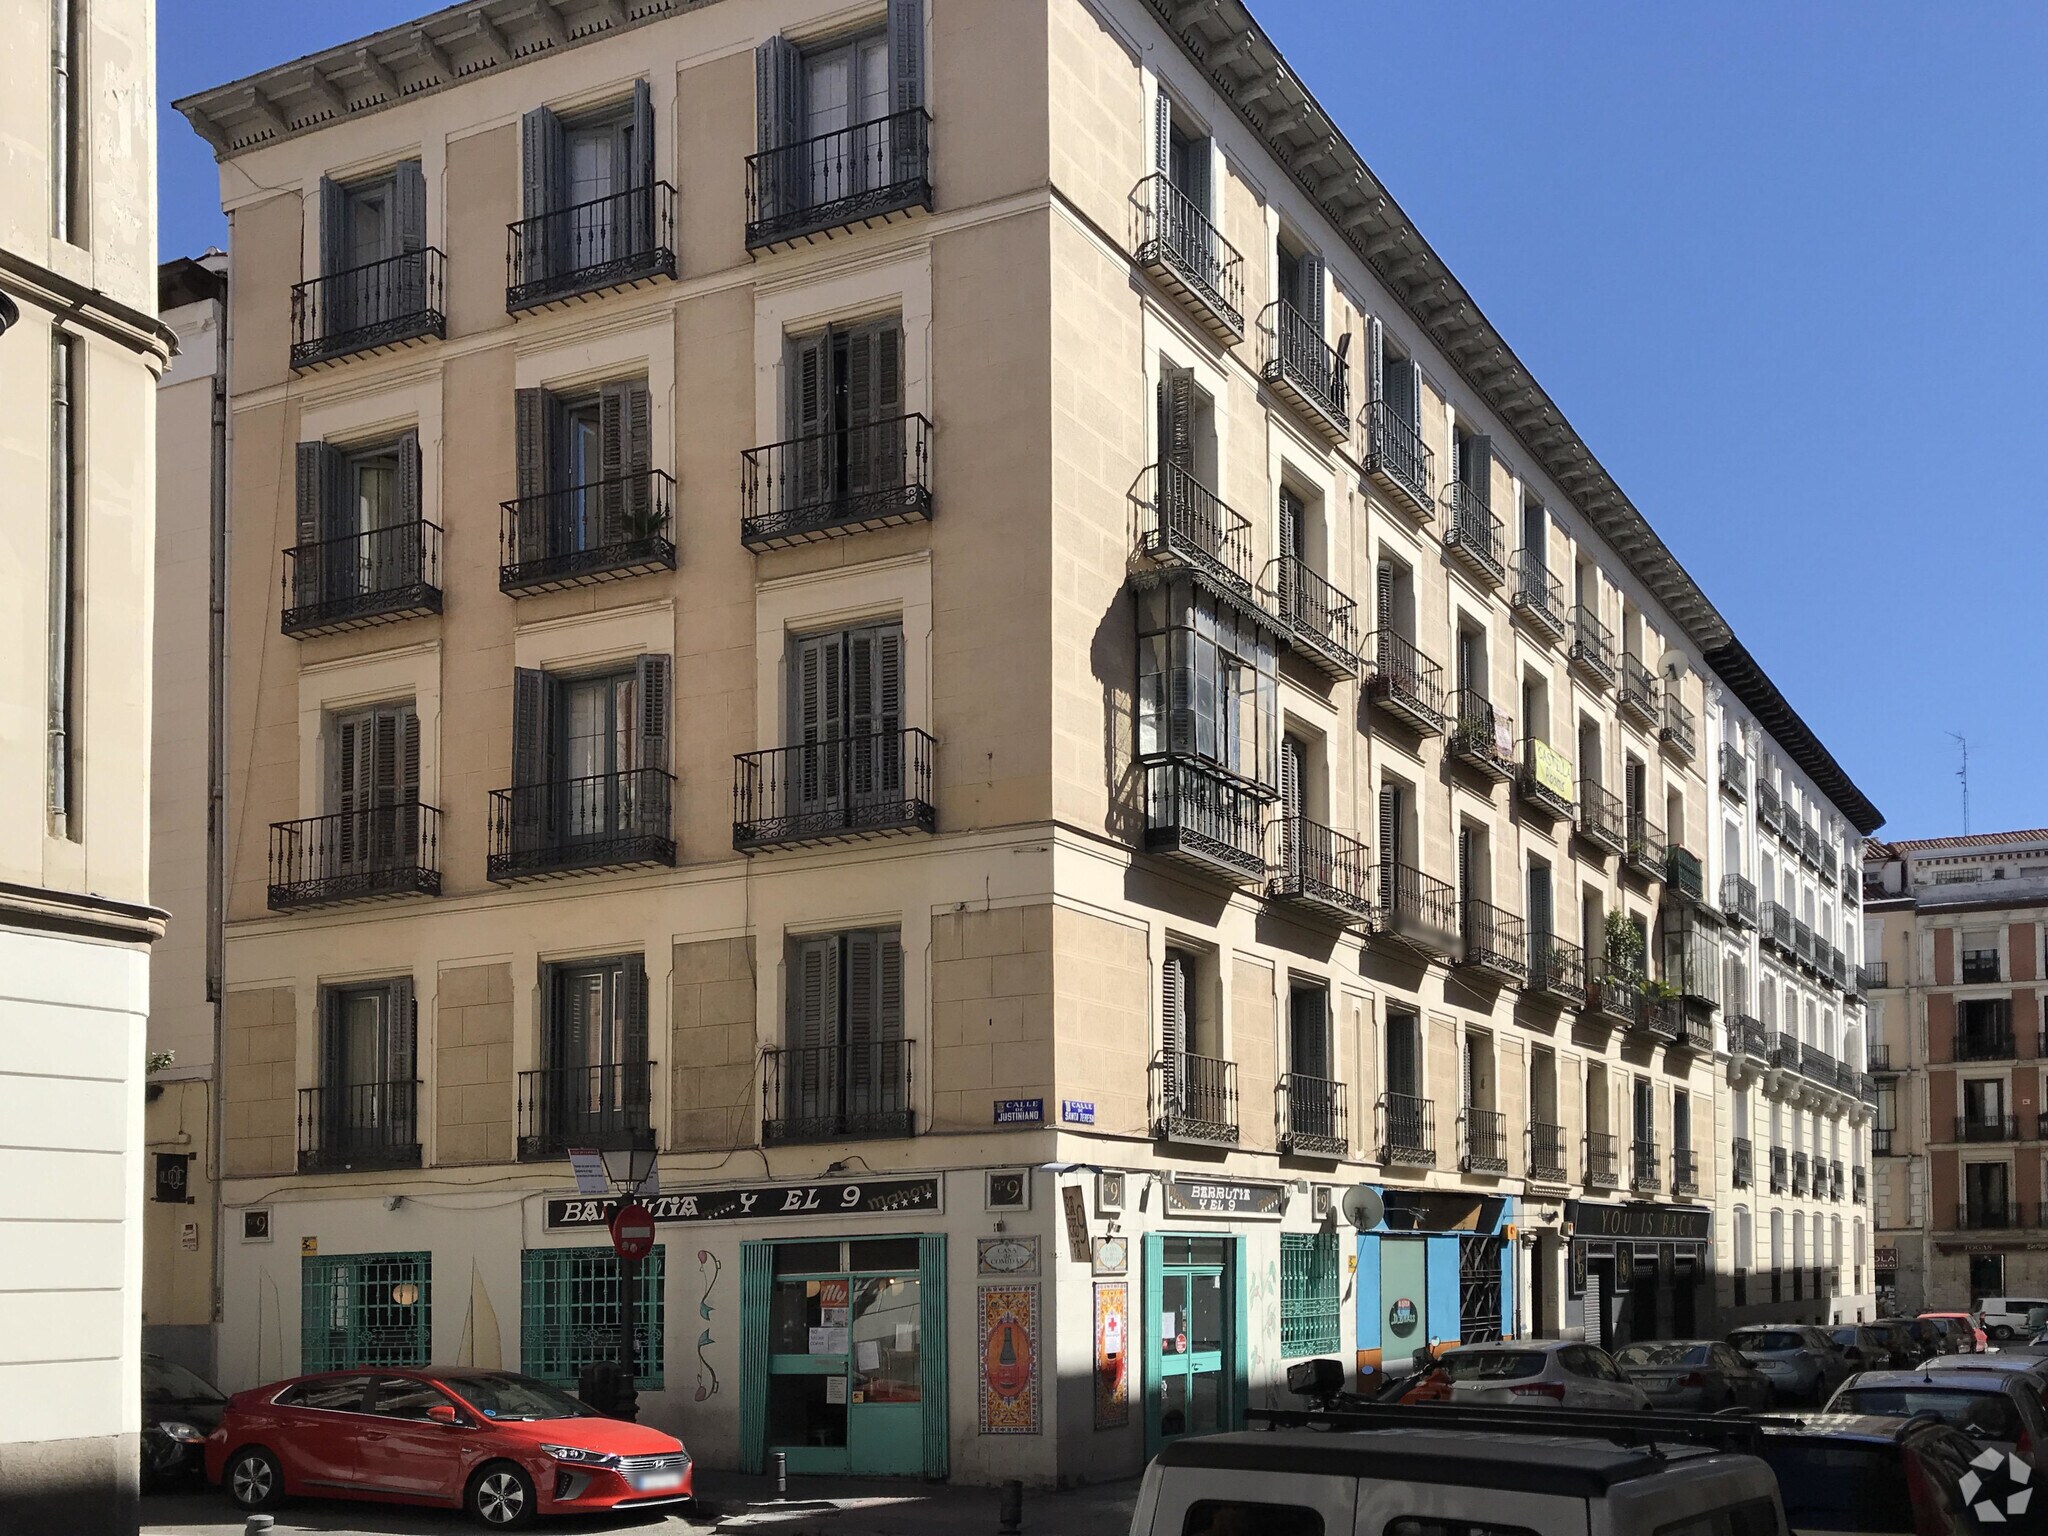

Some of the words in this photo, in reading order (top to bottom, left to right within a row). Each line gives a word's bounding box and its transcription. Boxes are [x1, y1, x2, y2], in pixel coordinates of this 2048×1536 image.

[1072, 1102, 1093, 1110] CALLE
[998, 1111, 1039, 1122] JUSTINIANO
[740, 1193, 758, 1213] Y
[779, 1189, 821, 1211] EL
[840, 1185, 861, 1207] 9
[1007, 1180, 1020, 1200] 9
[1110, 1182, 1118, 1201] 9
[1210, 1199, 1224, 1211] EL
[1228, 1199, 1236, 1211] 9
[256, 1215, 266, 1233] 9
[1602, 1210, 1632, 1234] YOU
[1641, 1212, 1654, 1234] IS
[1662, 1214, 1695, 1236] BACK
